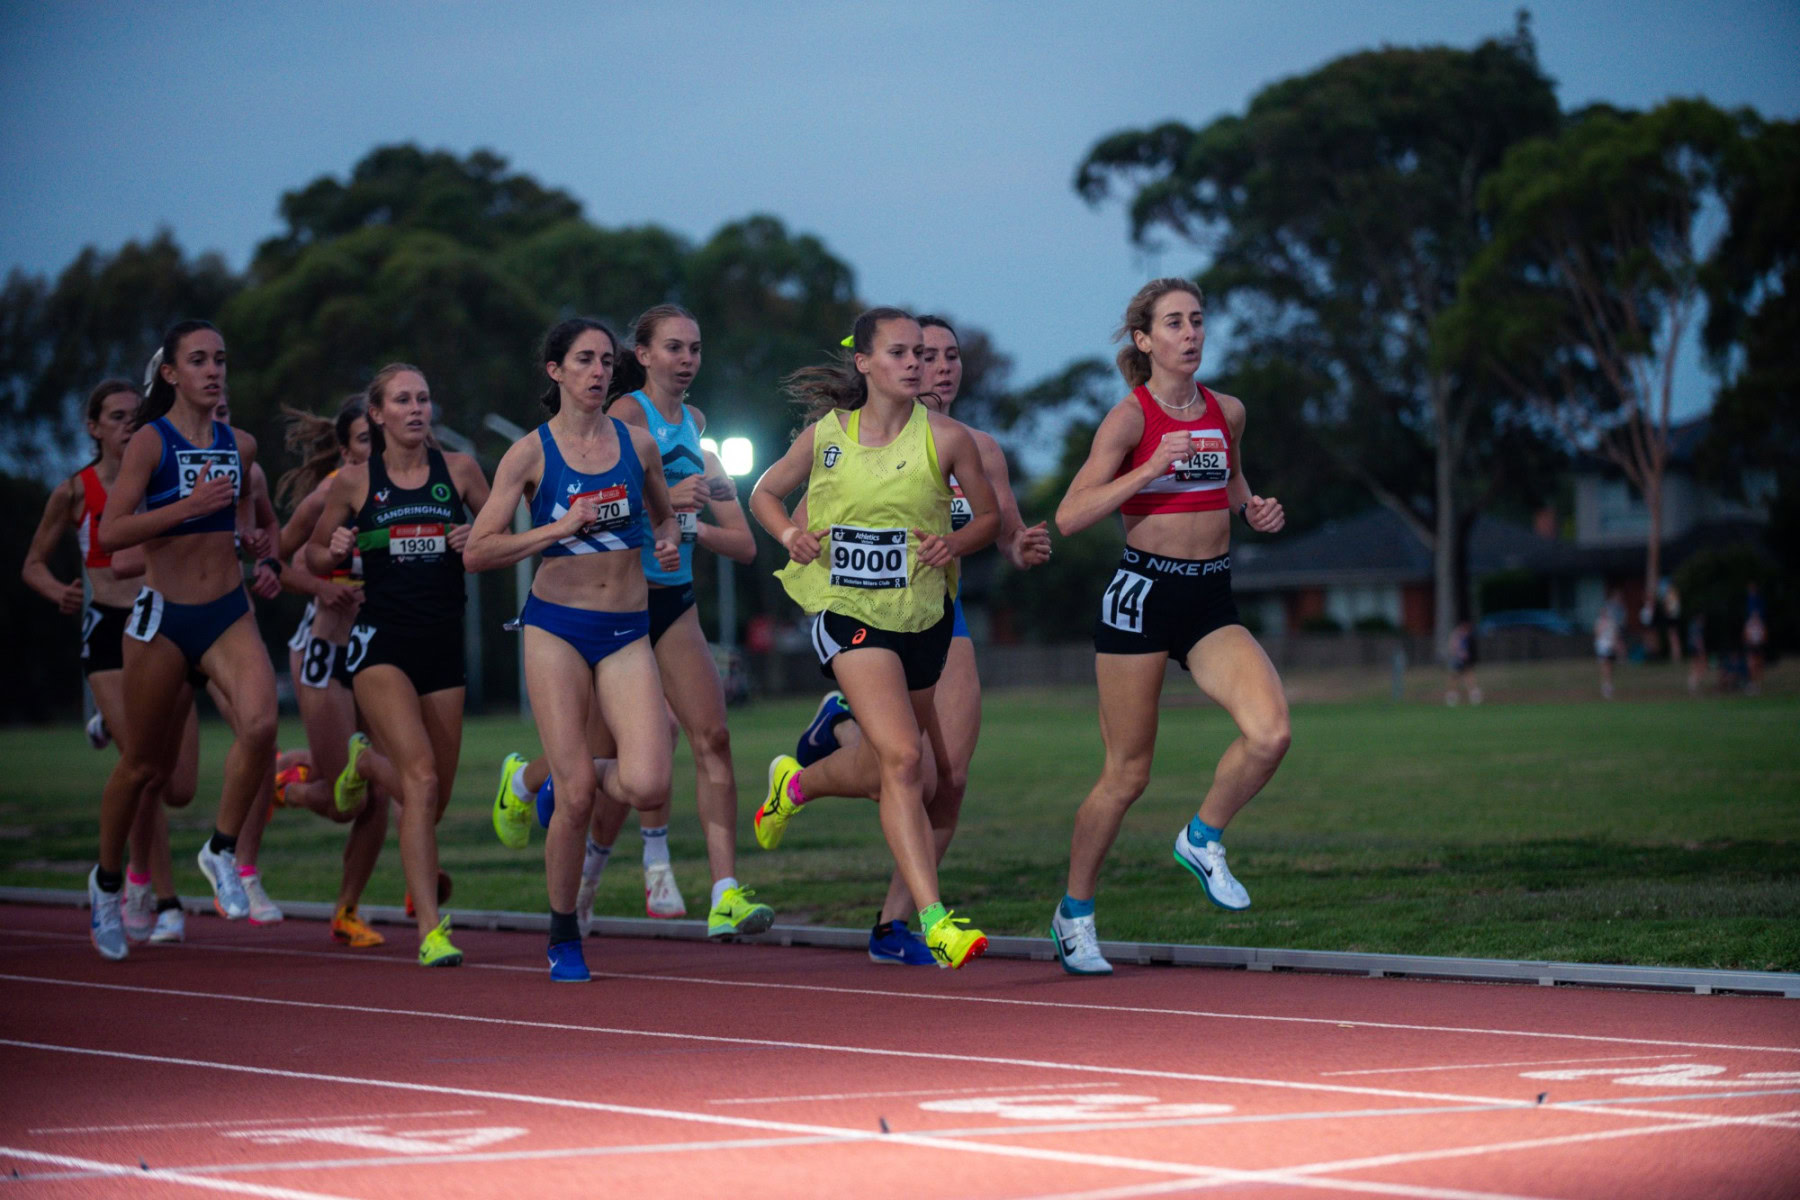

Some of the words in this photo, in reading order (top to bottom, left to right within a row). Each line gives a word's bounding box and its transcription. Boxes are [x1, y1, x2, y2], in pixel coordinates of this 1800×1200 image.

[1188, 454, 1219, 468] 1452
[377, 506, 451, 523] SANDRINGHAM
[400, 539, 435, 552] 1930
[855, 532, 880, 541] Athletics
[835, 547, 902, 572] 9000
[1146, 557, 1201, 576] NIKE
[1202, 556, 1231, 576] PRO
[1107, 574, 1147, 628] 14
[137, 591, 154, 637] 1
[306, 637, 330, 683] 8
